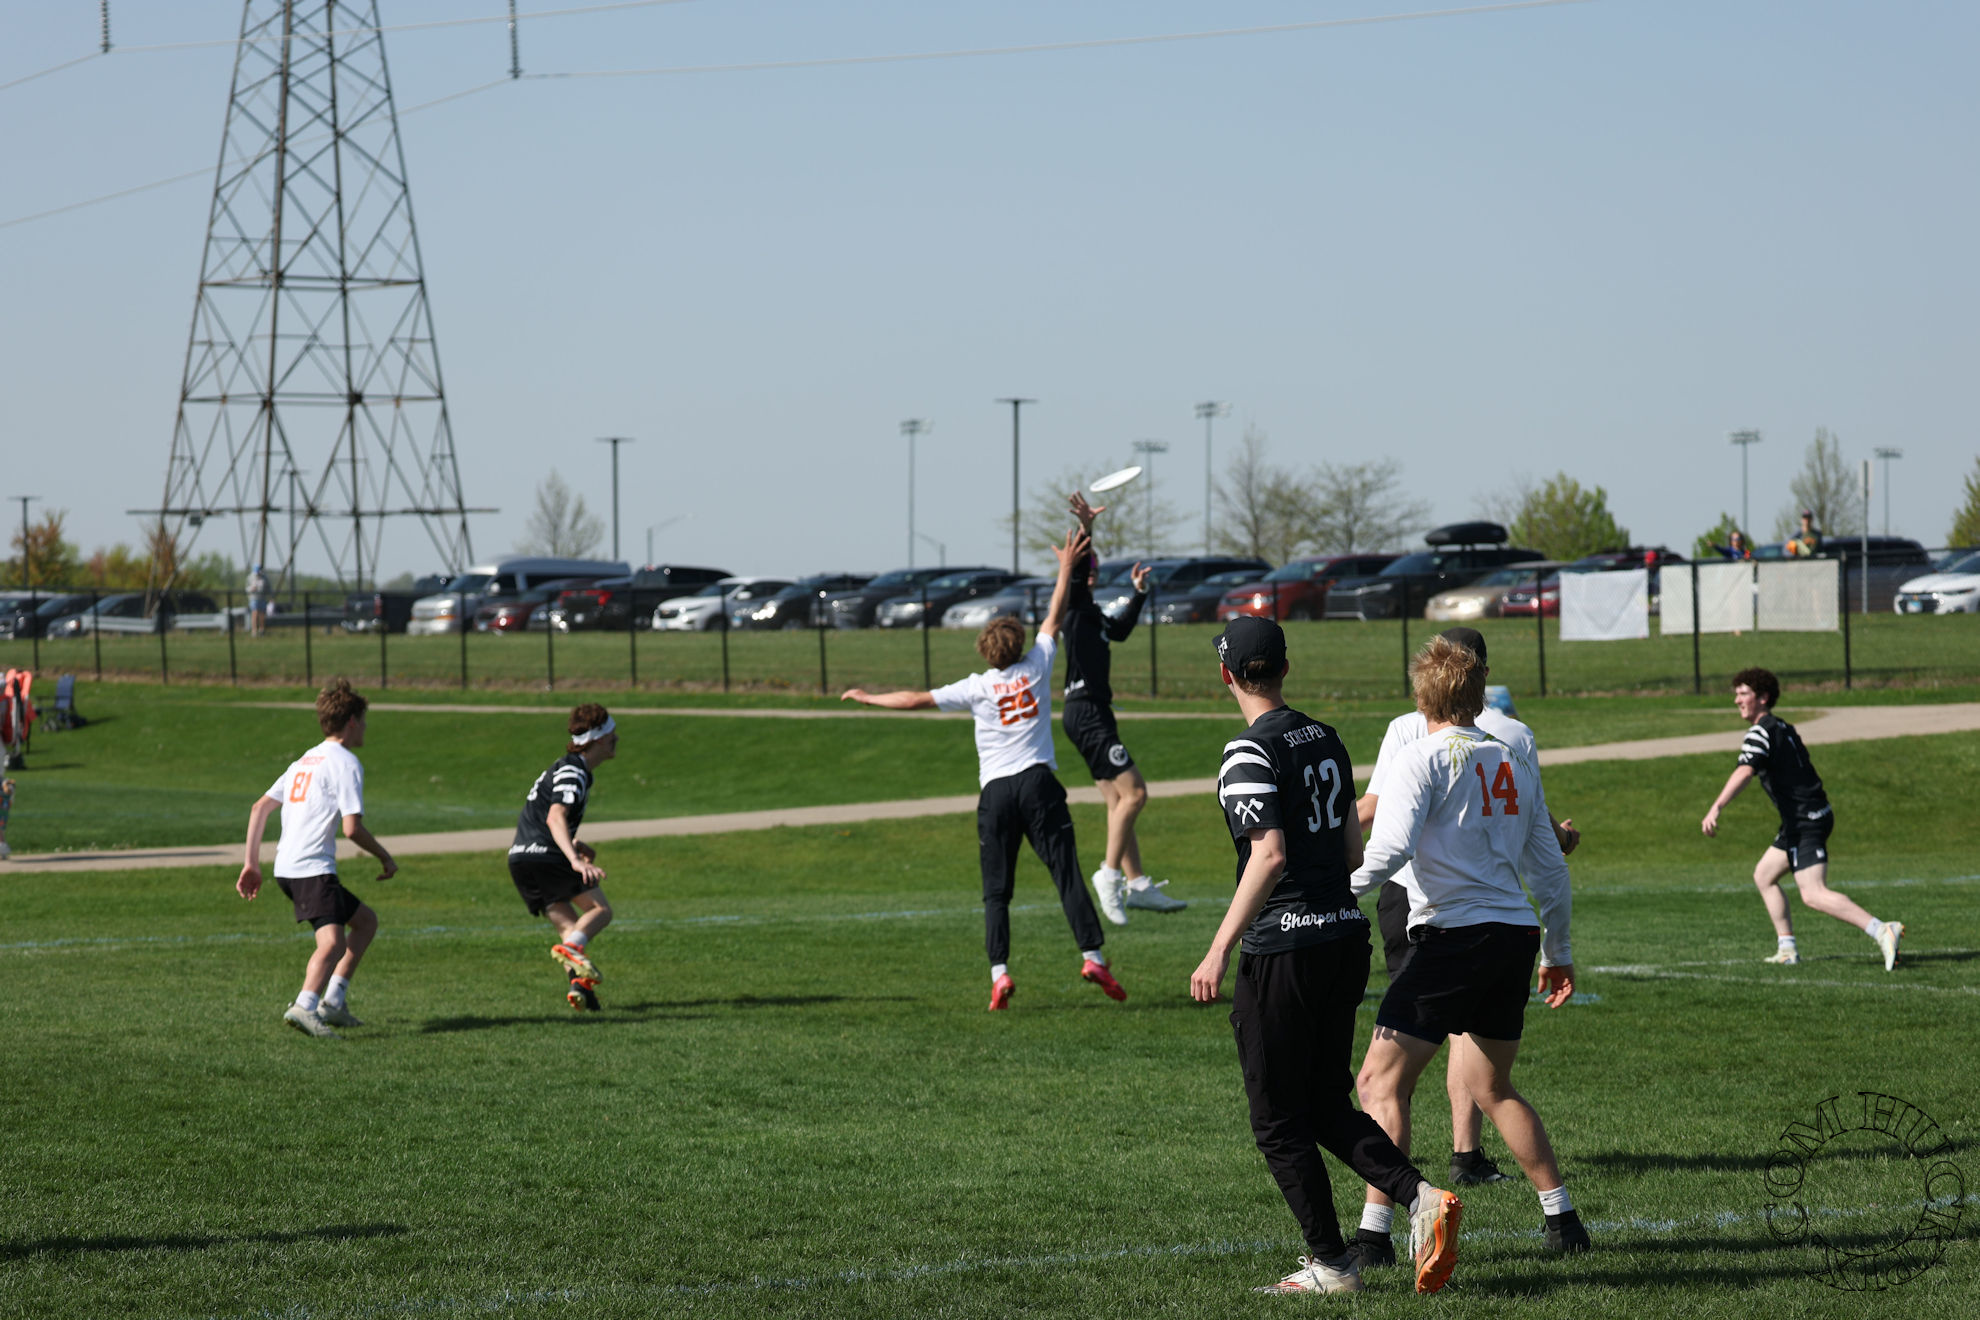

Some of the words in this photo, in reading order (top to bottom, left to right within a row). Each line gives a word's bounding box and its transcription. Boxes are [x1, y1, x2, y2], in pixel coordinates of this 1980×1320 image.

[997, 689, 1039, 726] 29
[289, 771, 313, 803] 81
[1304, 758, 1342, 833] 32
[1475, 761, 1519, 817] 14
[1280, 911, 1337, 932] Sharpen
